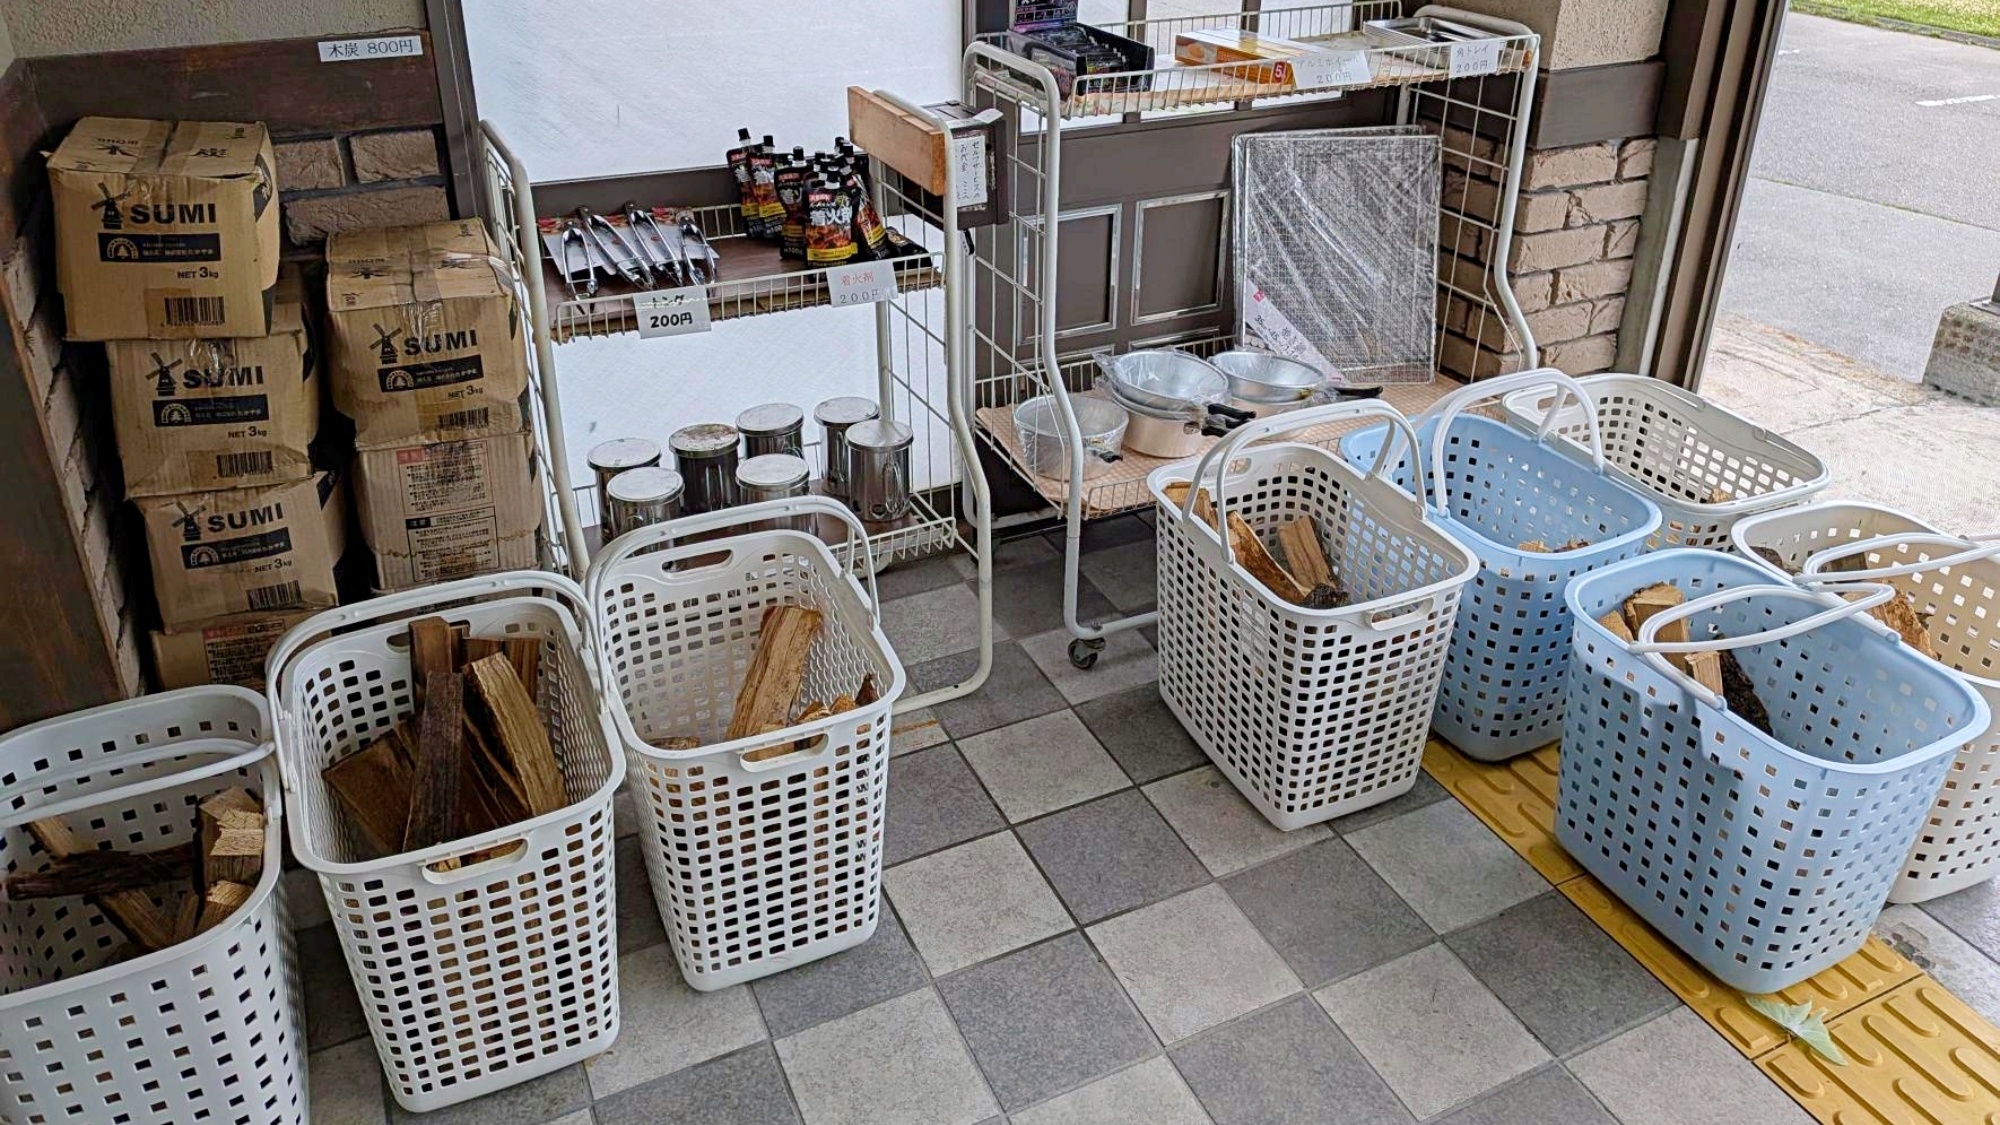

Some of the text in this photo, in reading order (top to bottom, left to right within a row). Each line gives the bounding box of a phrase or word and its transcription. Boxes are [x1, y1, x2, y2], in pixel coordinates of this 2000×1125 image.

[327, 39, 413, 58] 木炭 800円
[1456, 59, 1488, 74] 200円
[130, 203, 217, 224] SUMI
[177, 266, 219, 279] NET 3kg
[650, 311, 693, 329] 200円
[404, 329, 478, 356] SUMI
[183, 366, 265, 389] SUMI
[228, 426, 268, 439] NET 3kg
[207, 502, 284, 533] SUMI
[254, 563, 273, 573] NET
